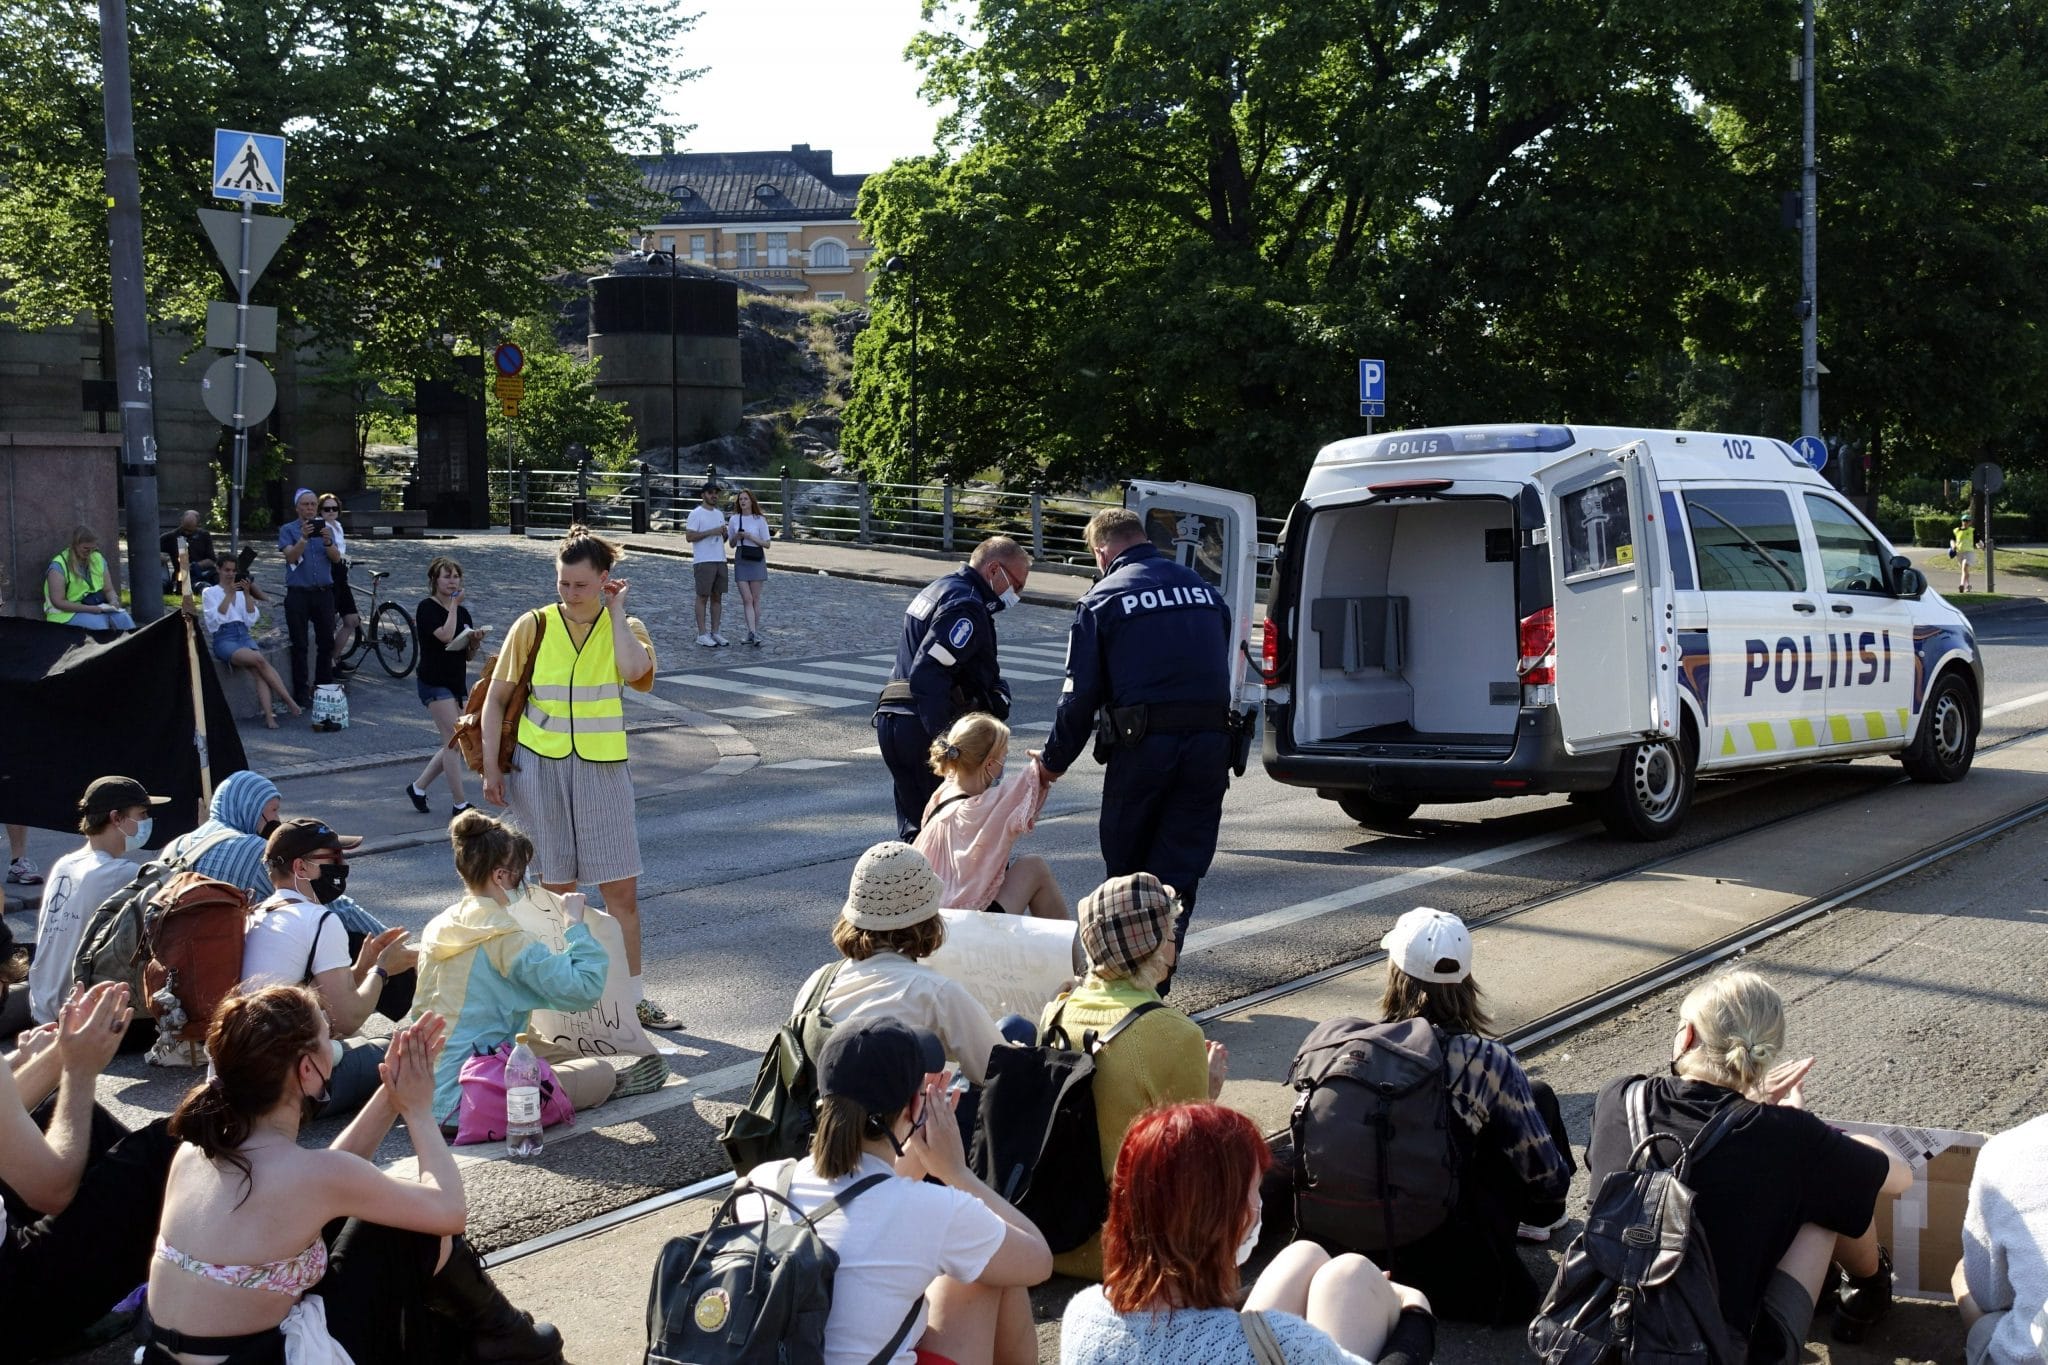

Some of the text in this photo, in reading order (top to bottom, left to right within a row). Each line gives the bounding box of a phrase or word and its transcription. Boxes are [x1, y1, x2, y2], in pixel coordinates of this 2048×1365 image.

[1365, 363, 1381, 398] P
[1387, 439, 1438, 456] POLIS
[1722, 439, 1755, 460] 102
[1121, 586, 1215, 615] POLIISI
[1743, 629, 1892, 697] POLIISI
